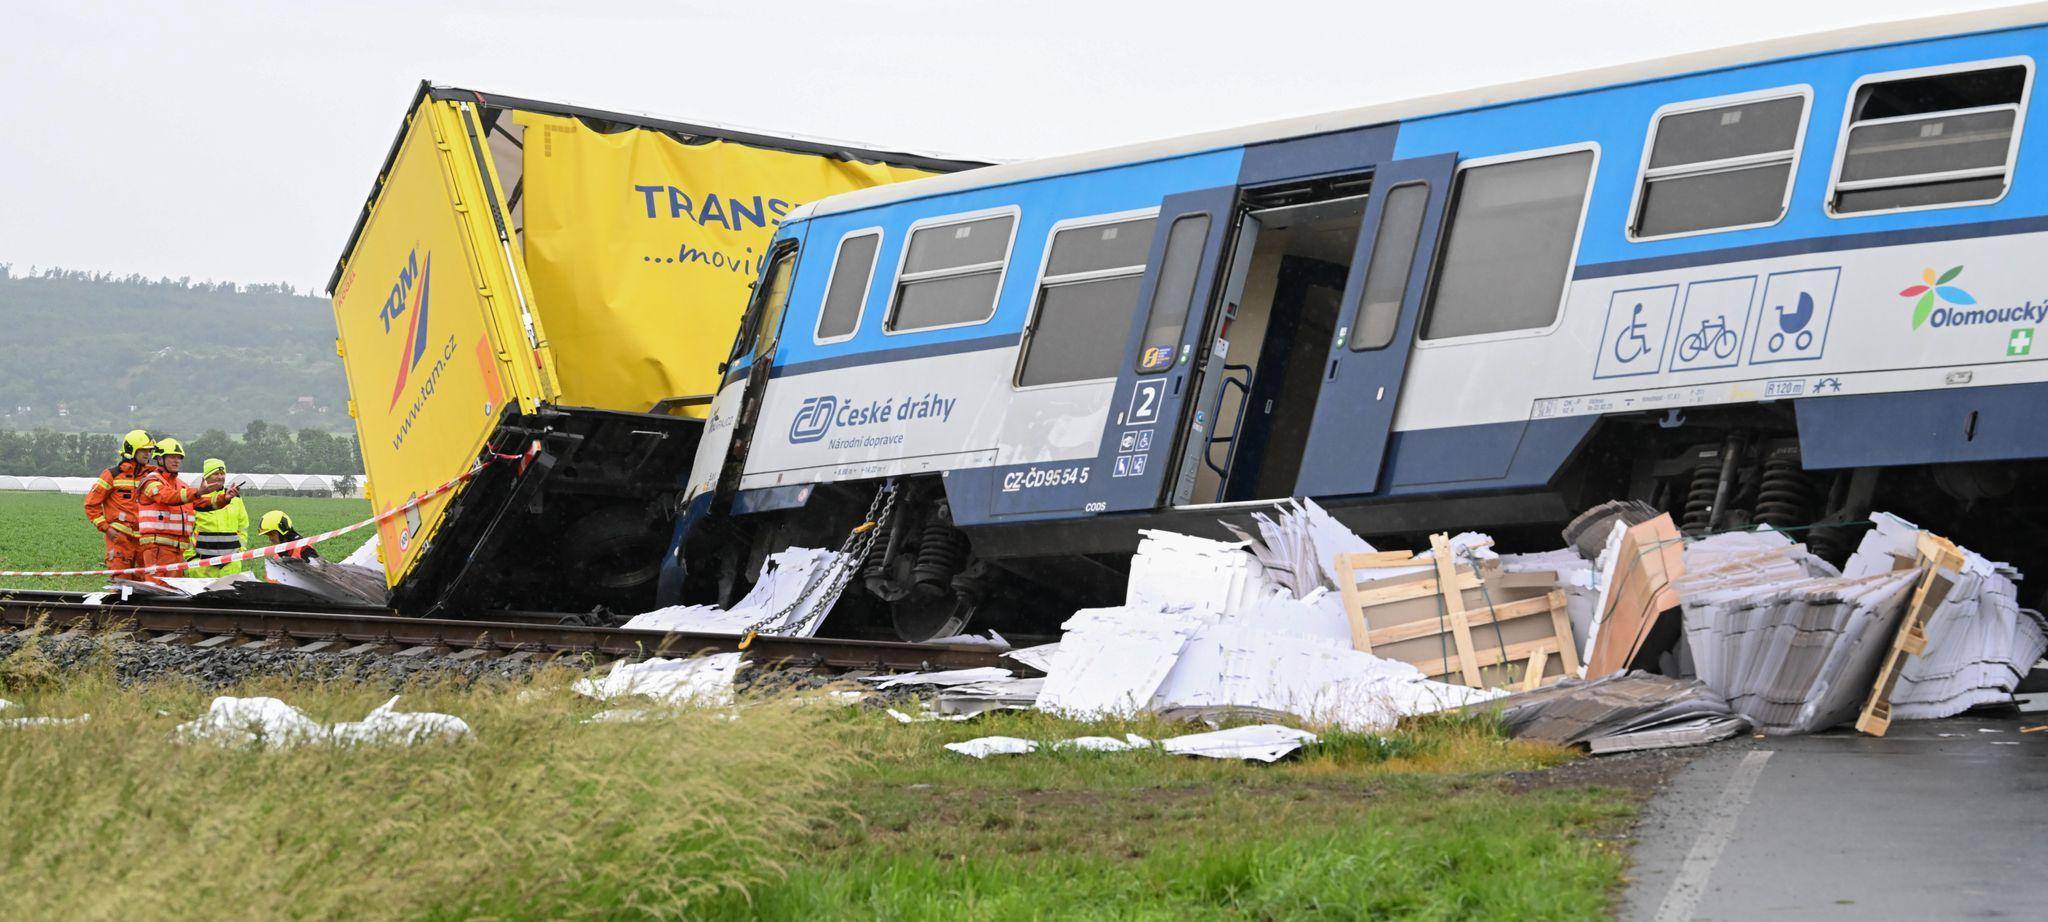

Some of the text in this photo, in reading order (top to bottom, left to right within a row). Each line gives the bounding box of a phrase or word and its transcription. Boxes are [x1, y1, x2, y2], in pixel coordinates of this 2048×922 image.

[635, 185, 802, 231] TRANS
[379, 248, 418, 335] TQM
[1930, 299, 2048, 328] Olomoucký
[392, 334, 457, 451] www.tqm.cz
[1136, 386, 1156, 417] 2
[1768, 381, 1775, 394] R
[1776, 381, 1792, 393] 120
[836, 393, 957, 428] České dráhy
[828, 434, 904, 450] Národní dopravce
[1079, 466, 1090, 484] 5
[1085, 502, 1107, 512] CODS
